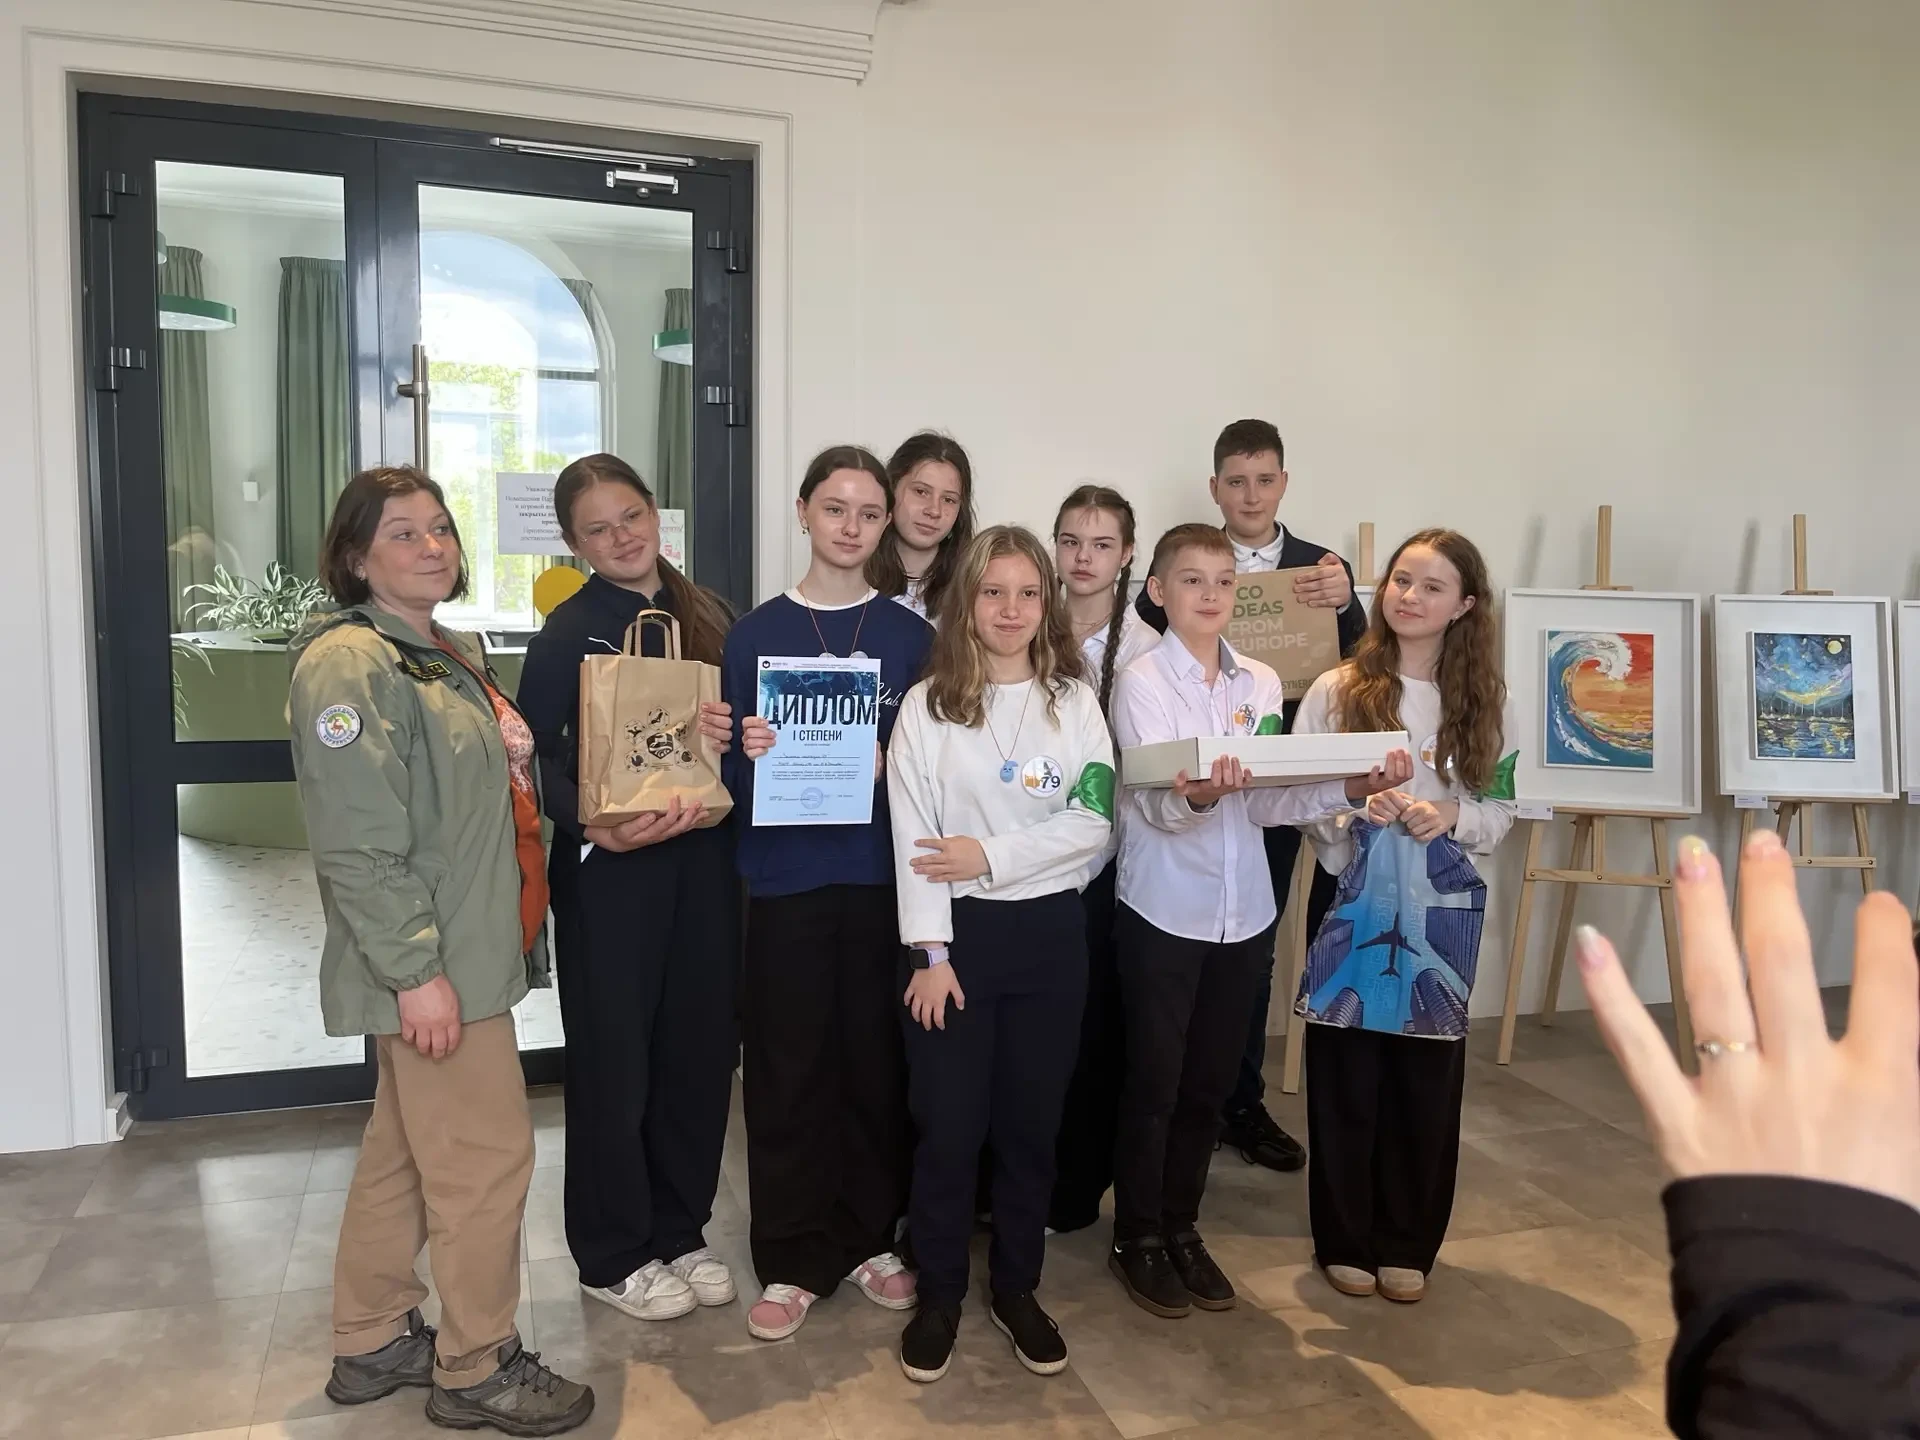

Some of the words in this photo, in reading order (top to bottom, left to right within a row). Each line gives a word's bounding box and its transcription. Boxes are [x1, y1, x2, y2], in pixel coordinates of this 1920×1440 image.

[1236, 585, 1263, 600] CO
[1232, 600, 1284, 618] DEAS
[1229, 618, 1283, 636] FROM
[1231, 633, 1308, 653] EUROPE
[763, 693, 877, 730] ДИПЛОМ
[799, 729, 842, 741] СТЕПЕНИ
[1040, 775, 1060, 789] 79
